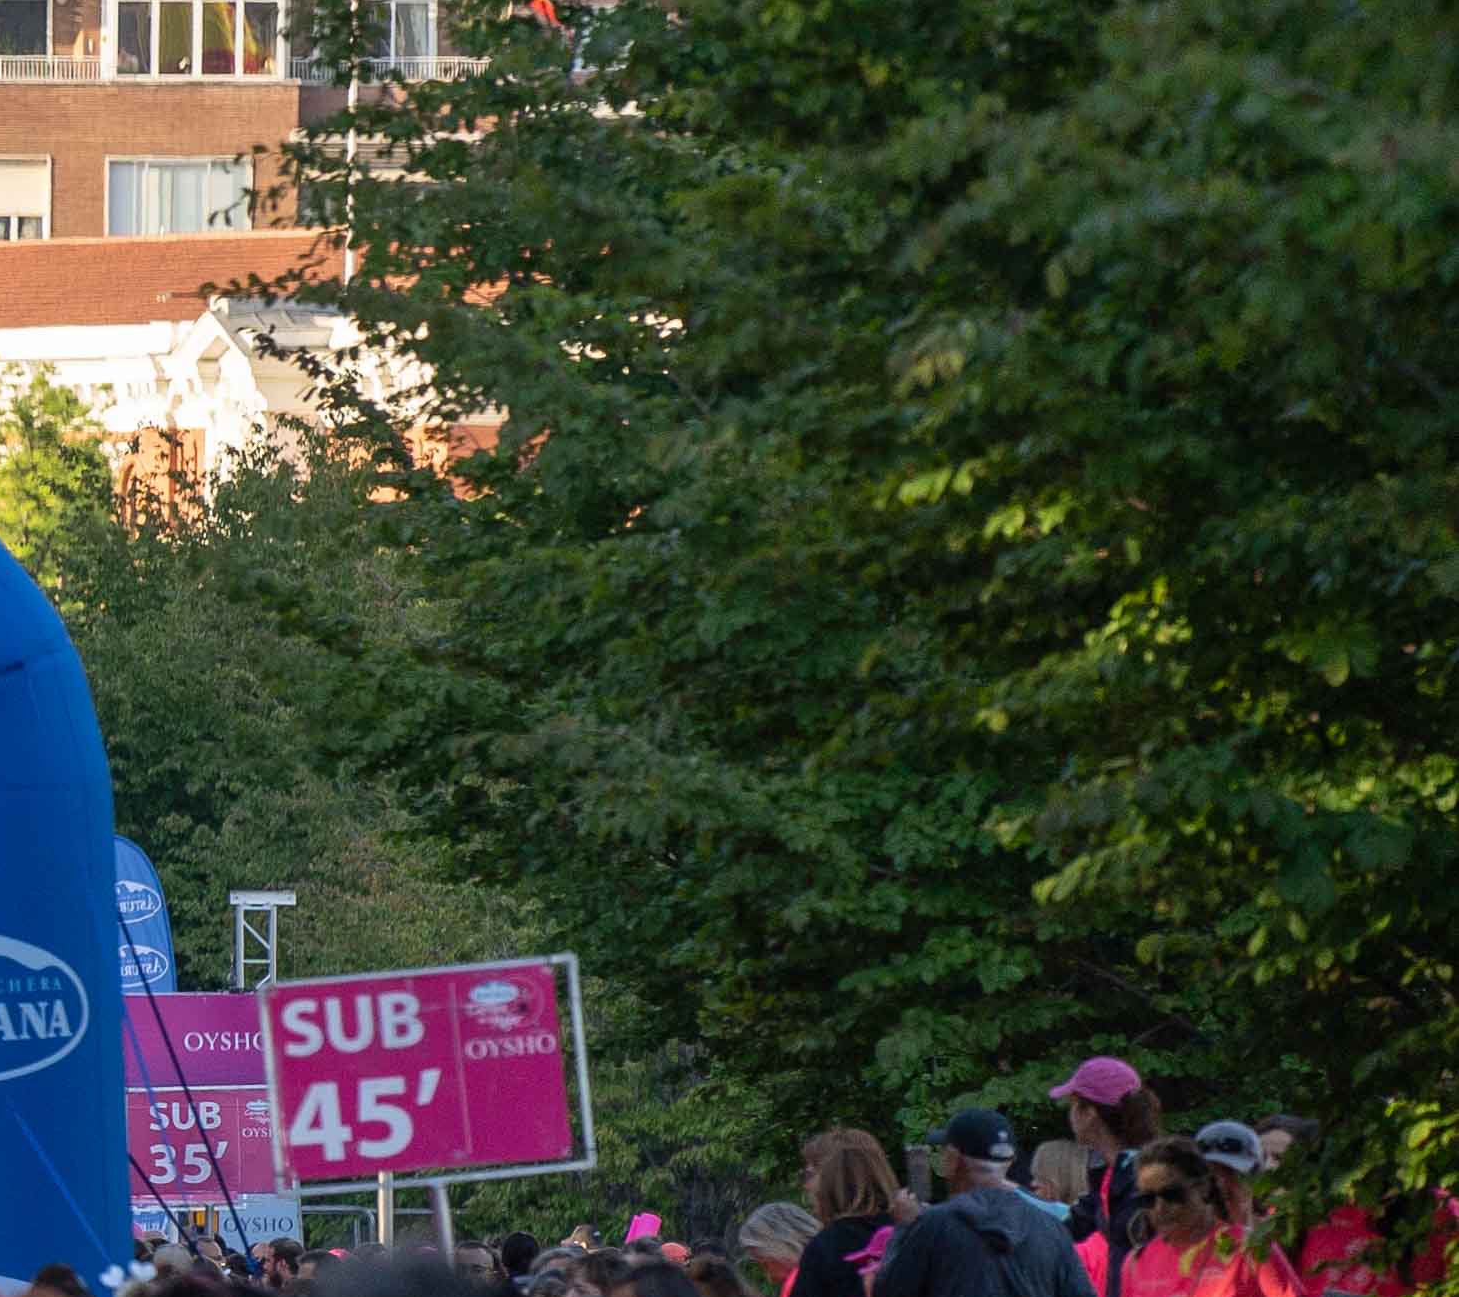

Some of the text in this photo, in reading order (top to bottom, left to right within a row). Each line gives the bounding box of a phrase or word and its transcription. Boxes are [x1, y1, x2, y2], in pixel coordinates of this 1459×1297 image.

[281, 991, 425, 1057] SUB
[464, 1032, 557, 1060] OYSHO
[149, 1100, 222, 1131] SUB
[223, 1215, 293, 1233] OYSHO
